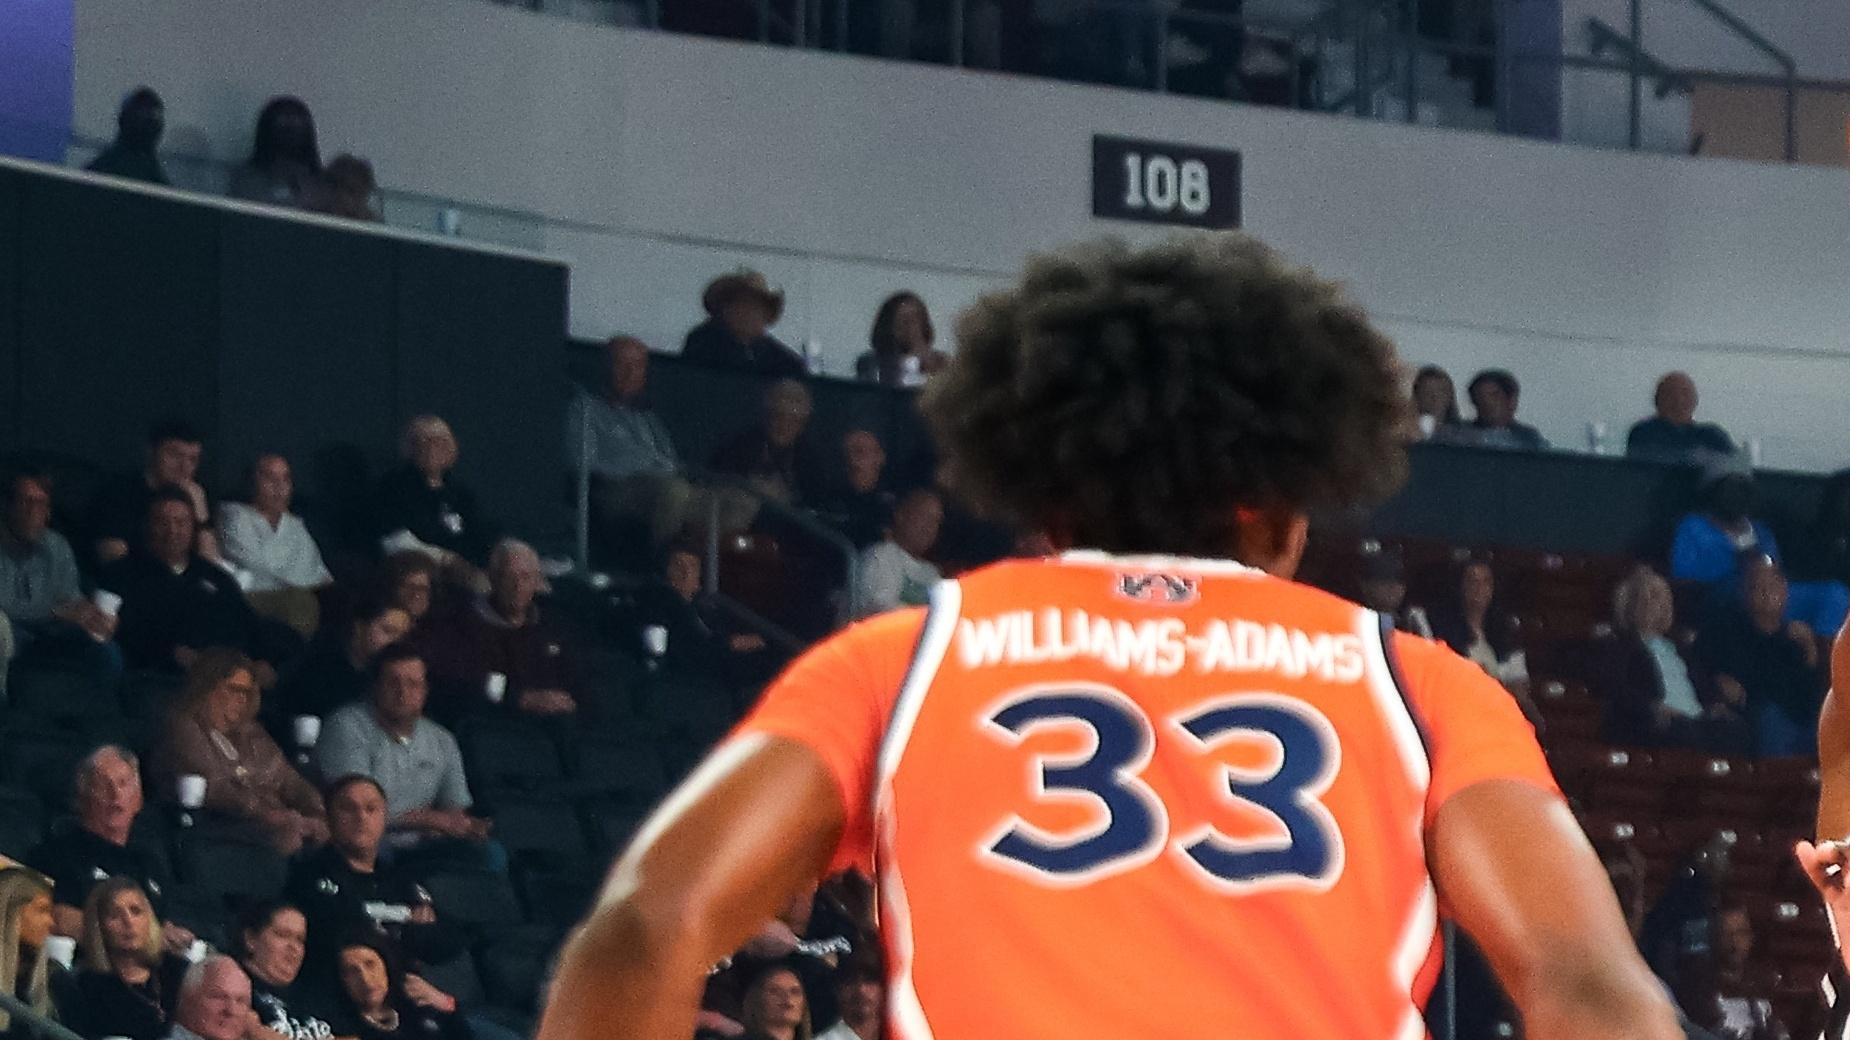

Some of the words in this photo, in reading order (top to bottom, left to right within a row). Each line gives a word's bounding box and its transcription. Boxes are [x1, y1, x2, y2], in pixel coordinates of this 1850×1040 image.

[1126, 154, 1211, 214] 108
[960, 608, 1366, 682] WILLIAMS-ADAMS
[978, 680, 1347, 896] 33
